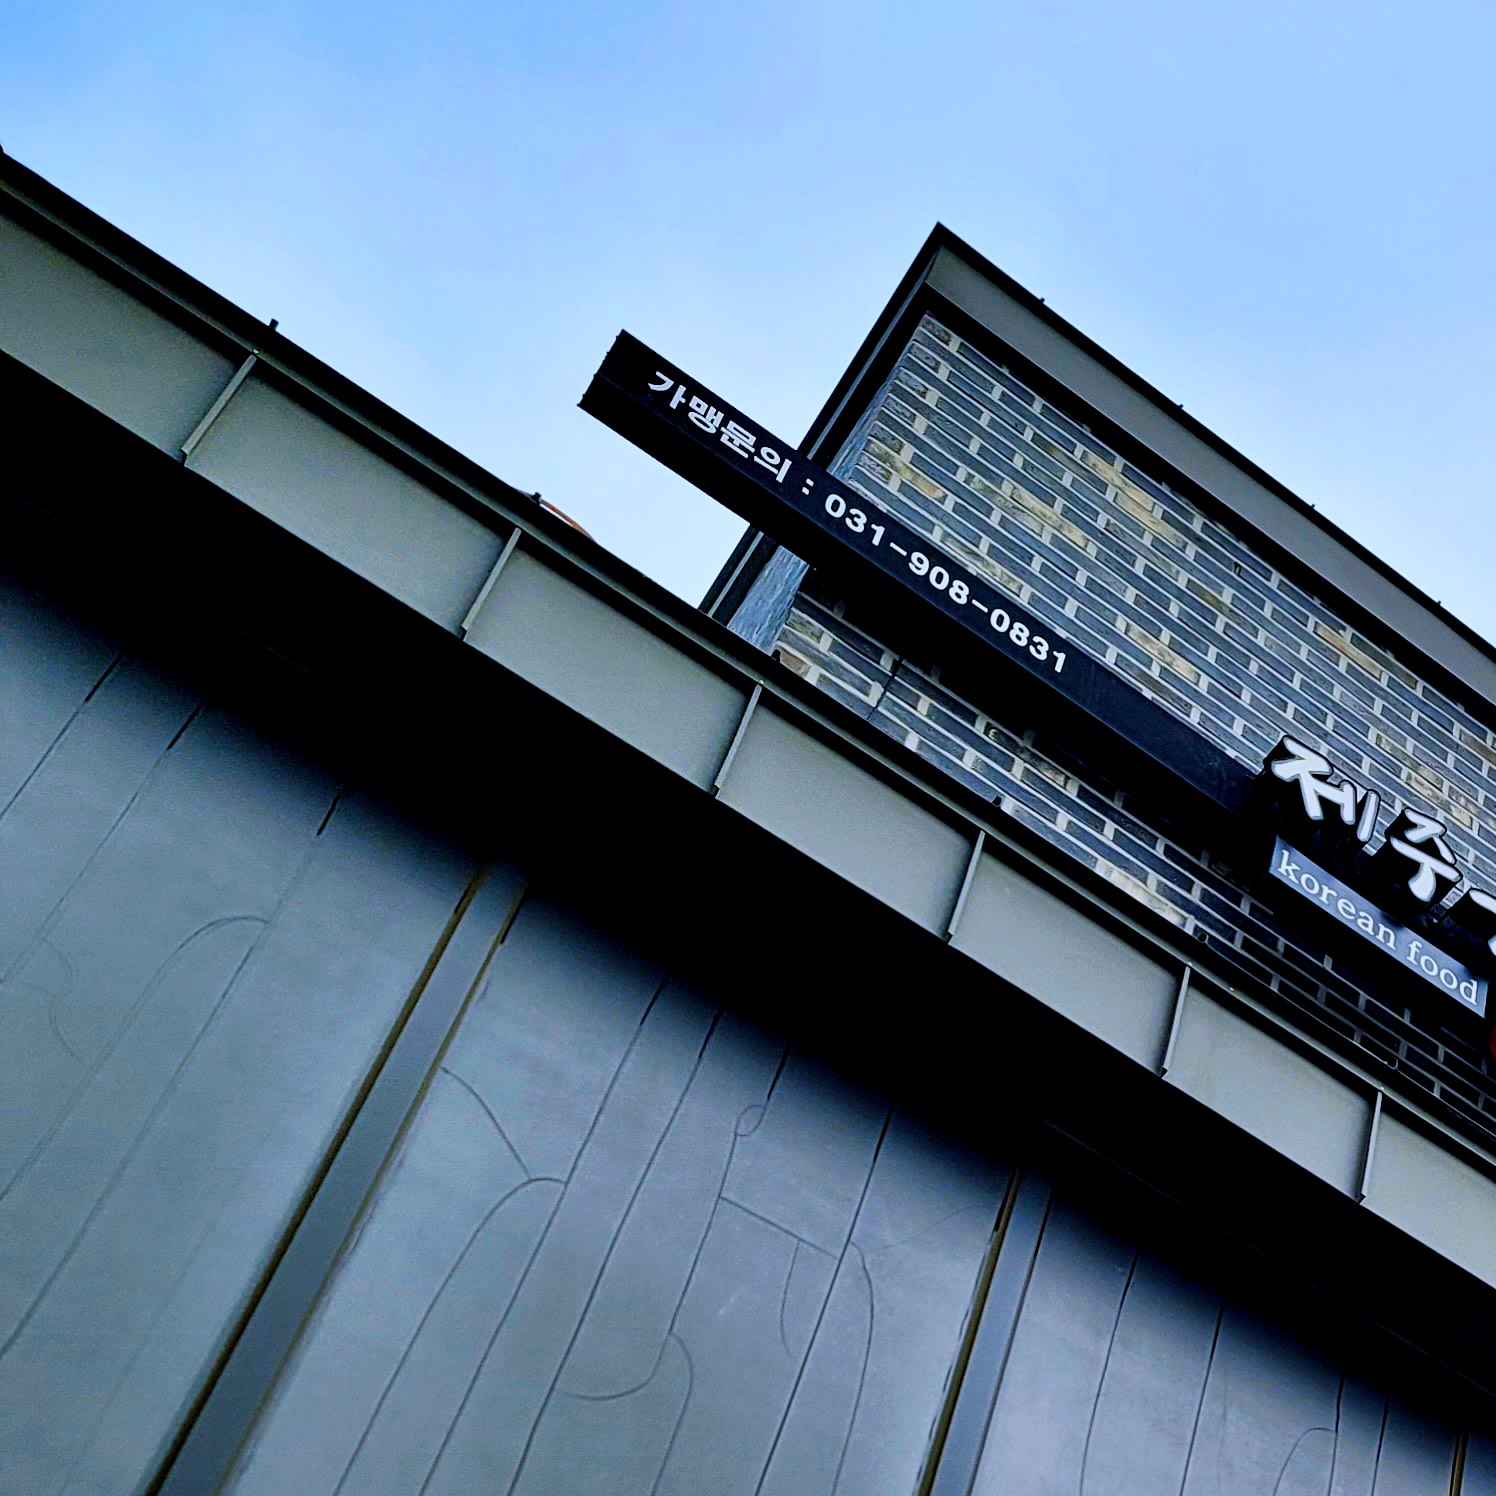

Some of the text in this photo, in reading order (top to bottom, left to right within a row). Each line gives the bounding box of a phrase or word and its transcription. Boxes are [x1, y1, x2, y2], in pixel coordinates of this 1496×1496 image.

[647, 371, 793, 484] 가맹문의
[824, 493, 1069, 674] 031-908-0831
[1276, 849, 1479, 1006] korean food
